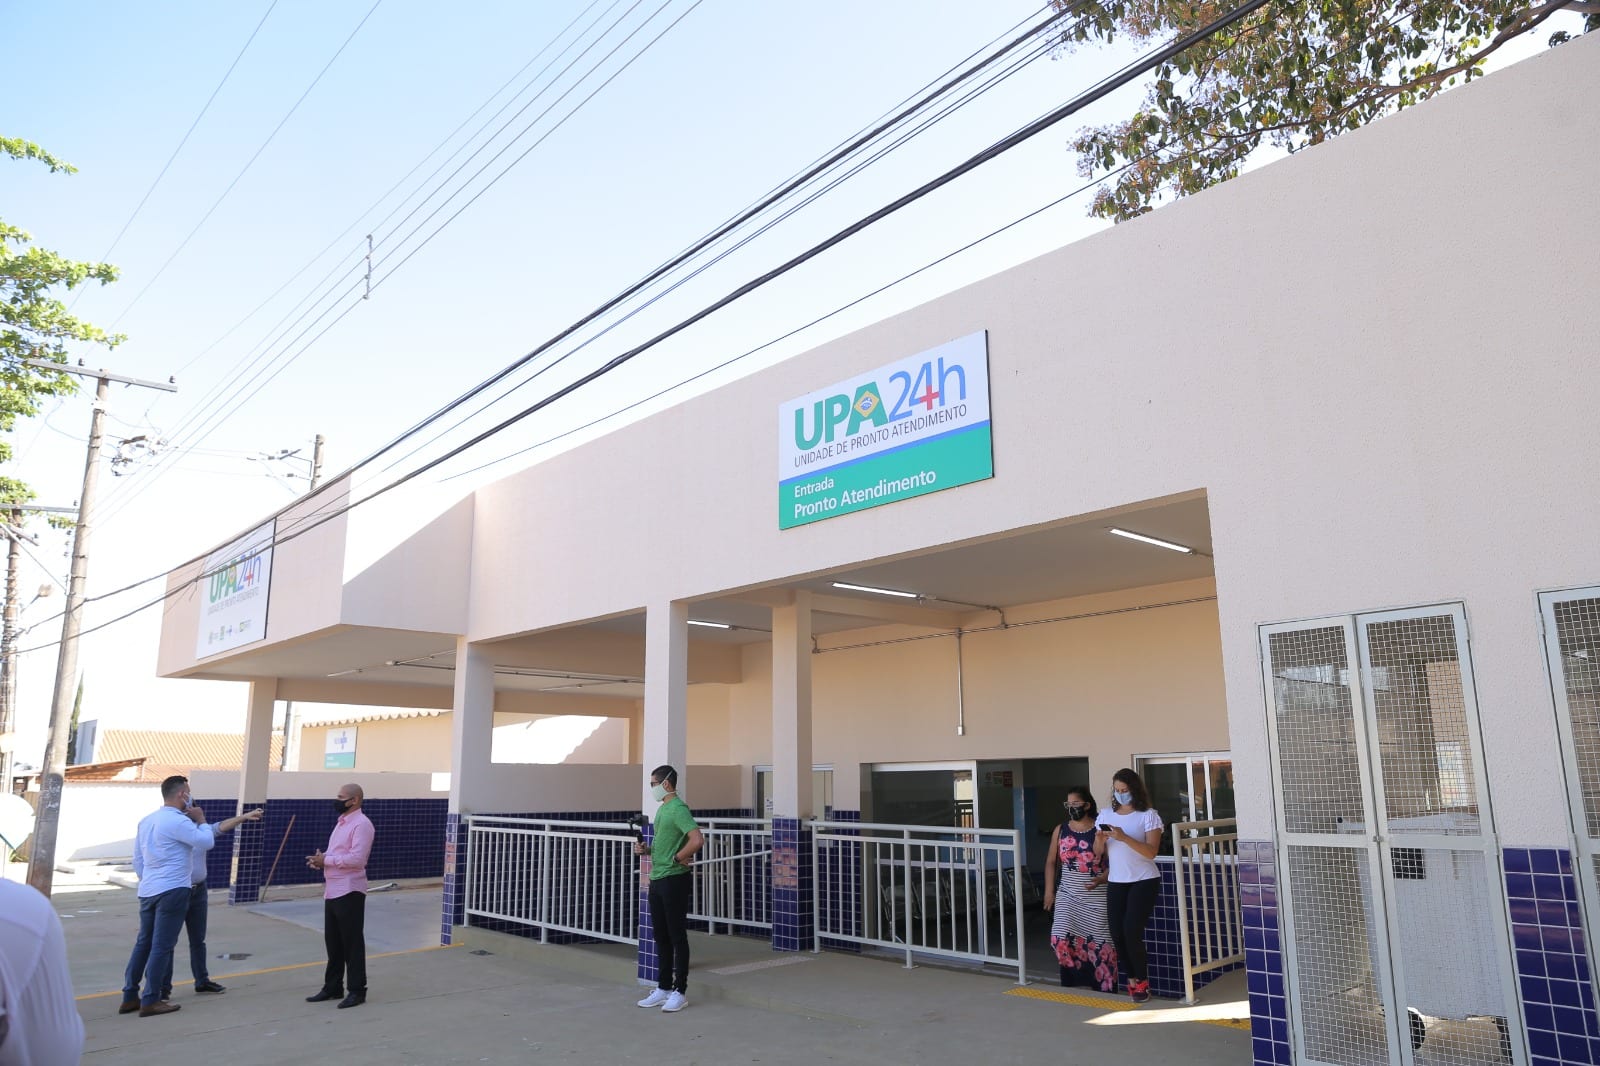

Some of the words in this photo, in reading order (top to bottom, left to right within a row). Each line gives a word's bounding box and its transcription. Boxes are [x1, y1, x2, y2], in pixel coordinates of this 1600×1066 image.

[794, 445, 833, 468] UNIDADE
[836, 440, 847, 455] DE
[851, 428, 889, 451] PRONTO
[891, 404, 967, 438] ATENDIMENTO
[794, 477, 834, 498] Entrada
[794, 496, 837, 518] Pronto
[841, 470, 936, 506] Atendimento
